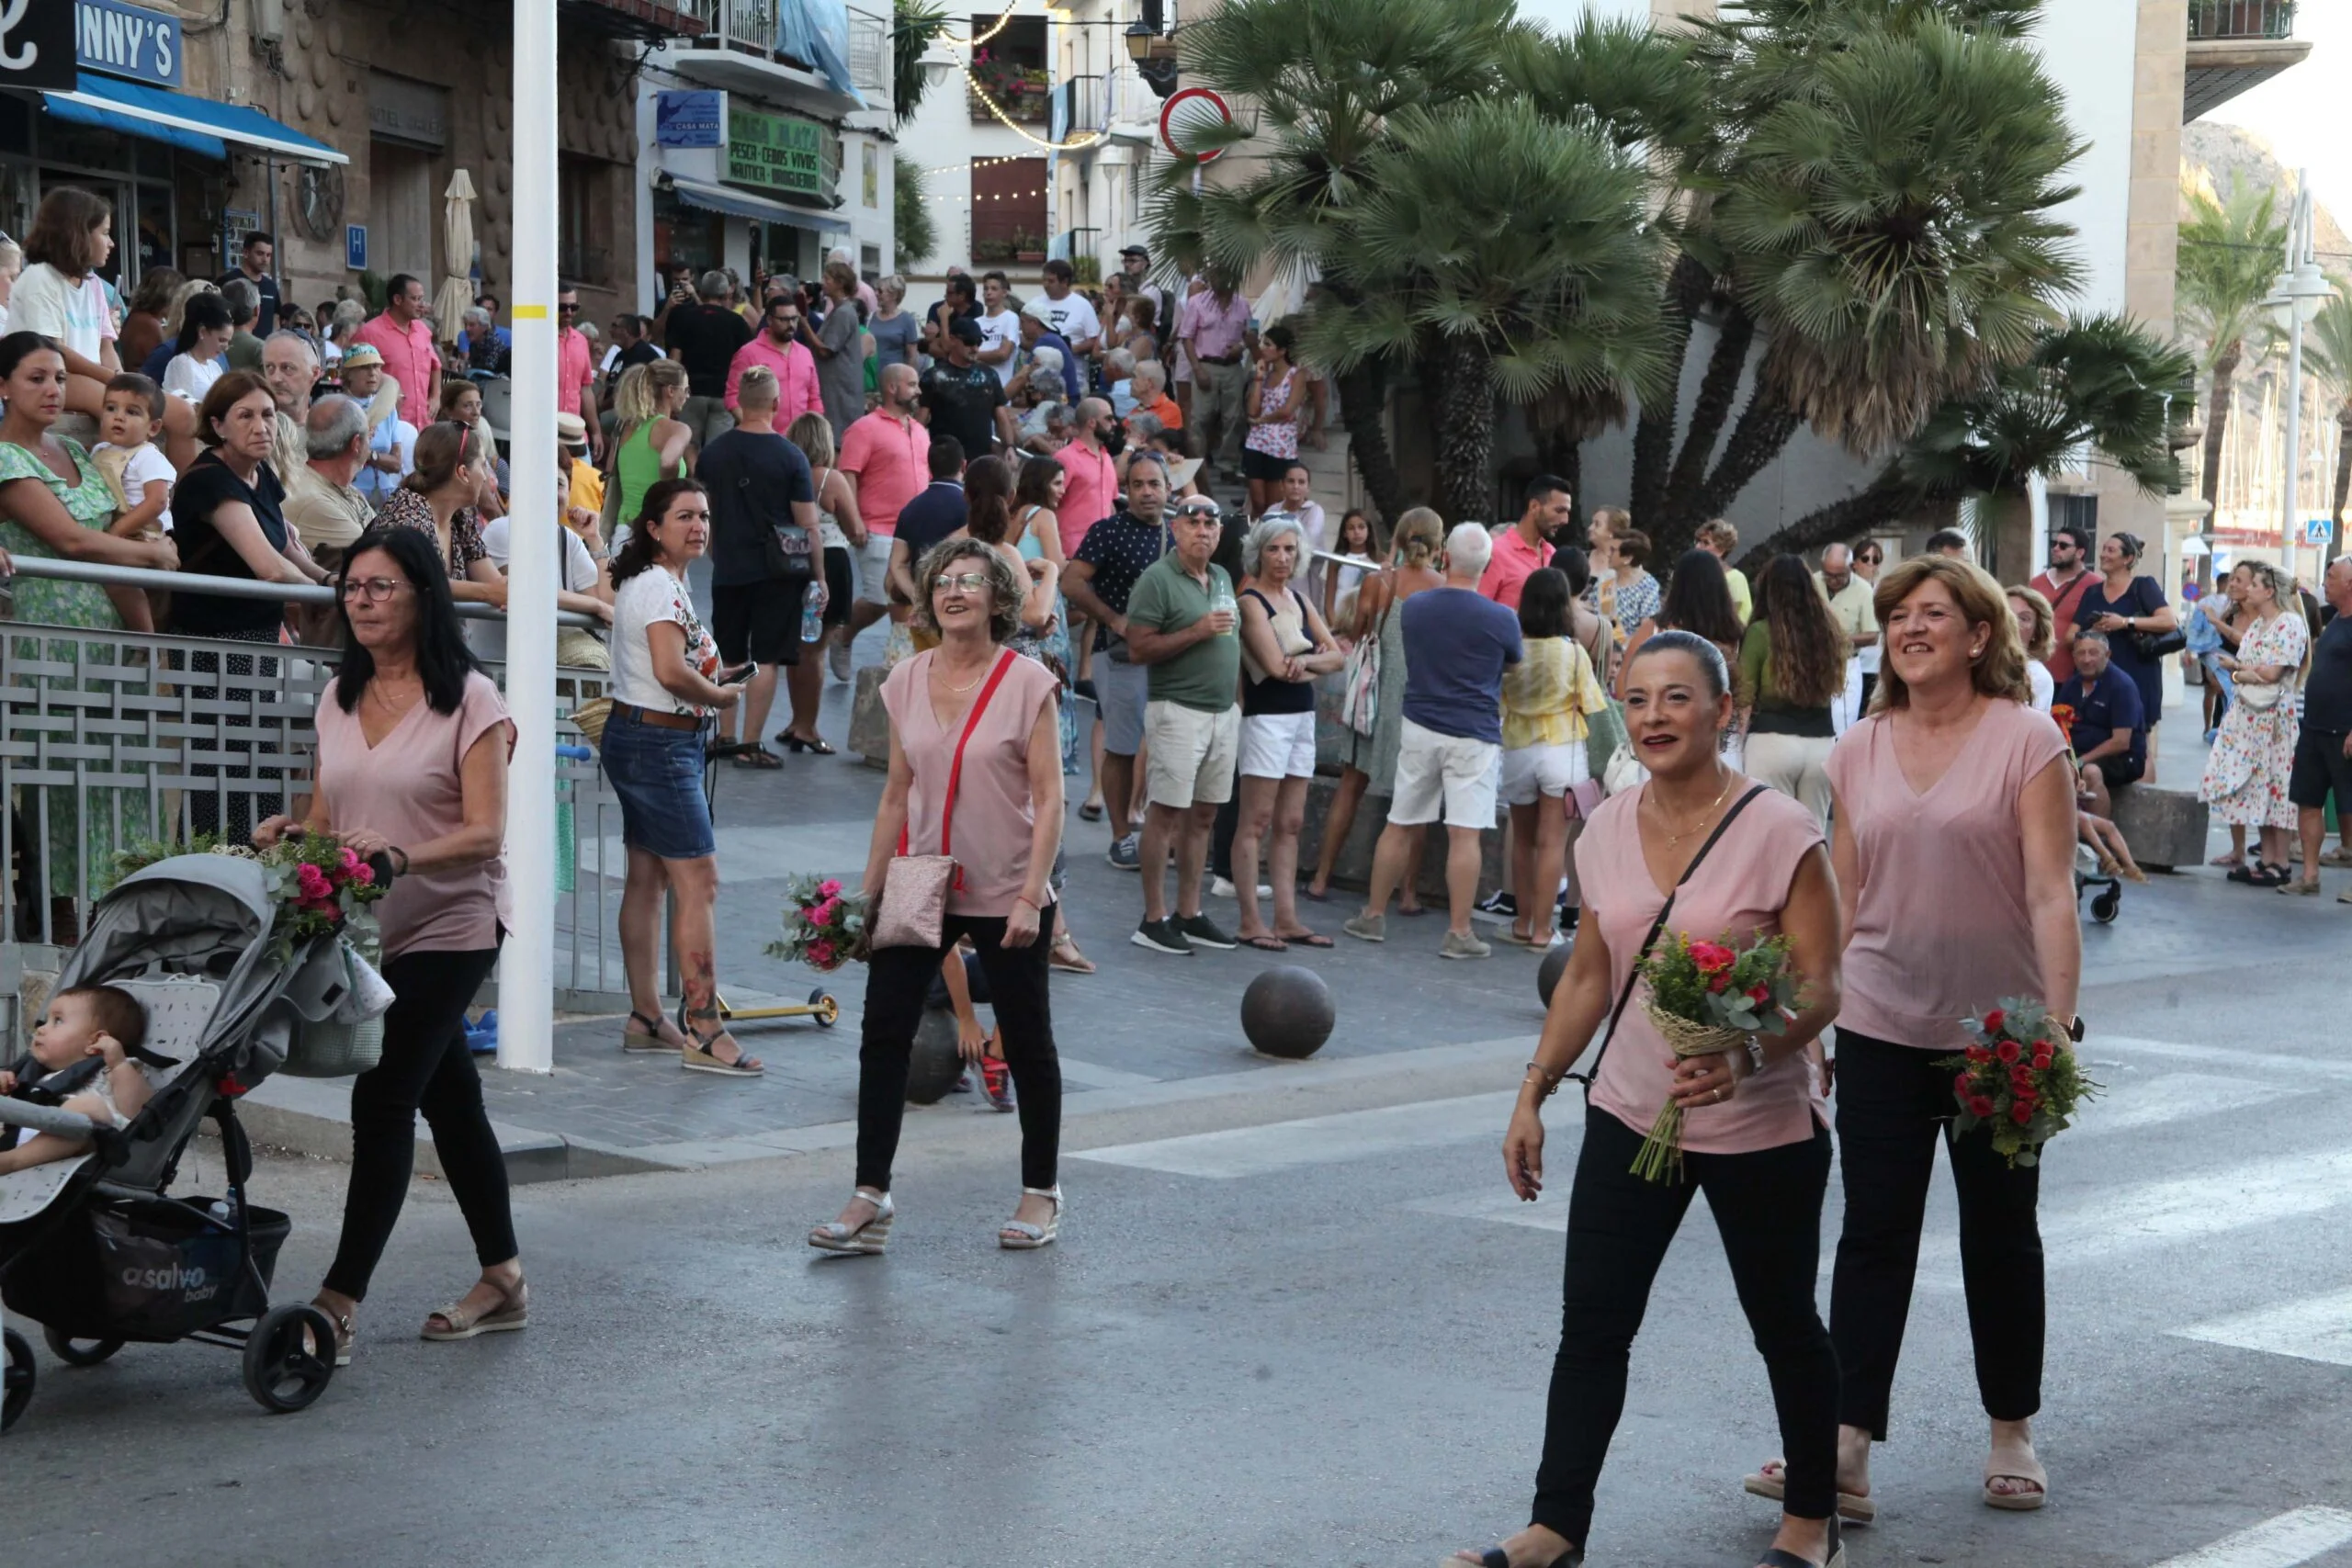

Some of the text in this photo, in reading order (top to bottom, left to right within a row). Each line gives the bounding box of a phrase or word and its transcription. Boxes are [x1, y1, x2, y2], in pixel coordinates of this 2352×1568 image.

[676, 122, 719, 130] CASA MATA
[730, 141, 757, 161] PESCA
[791, 152, 817, 171] VIVOS
[122, 1261, 206, 1291] asalvo
[185, 1283, 220, 1303] baby
